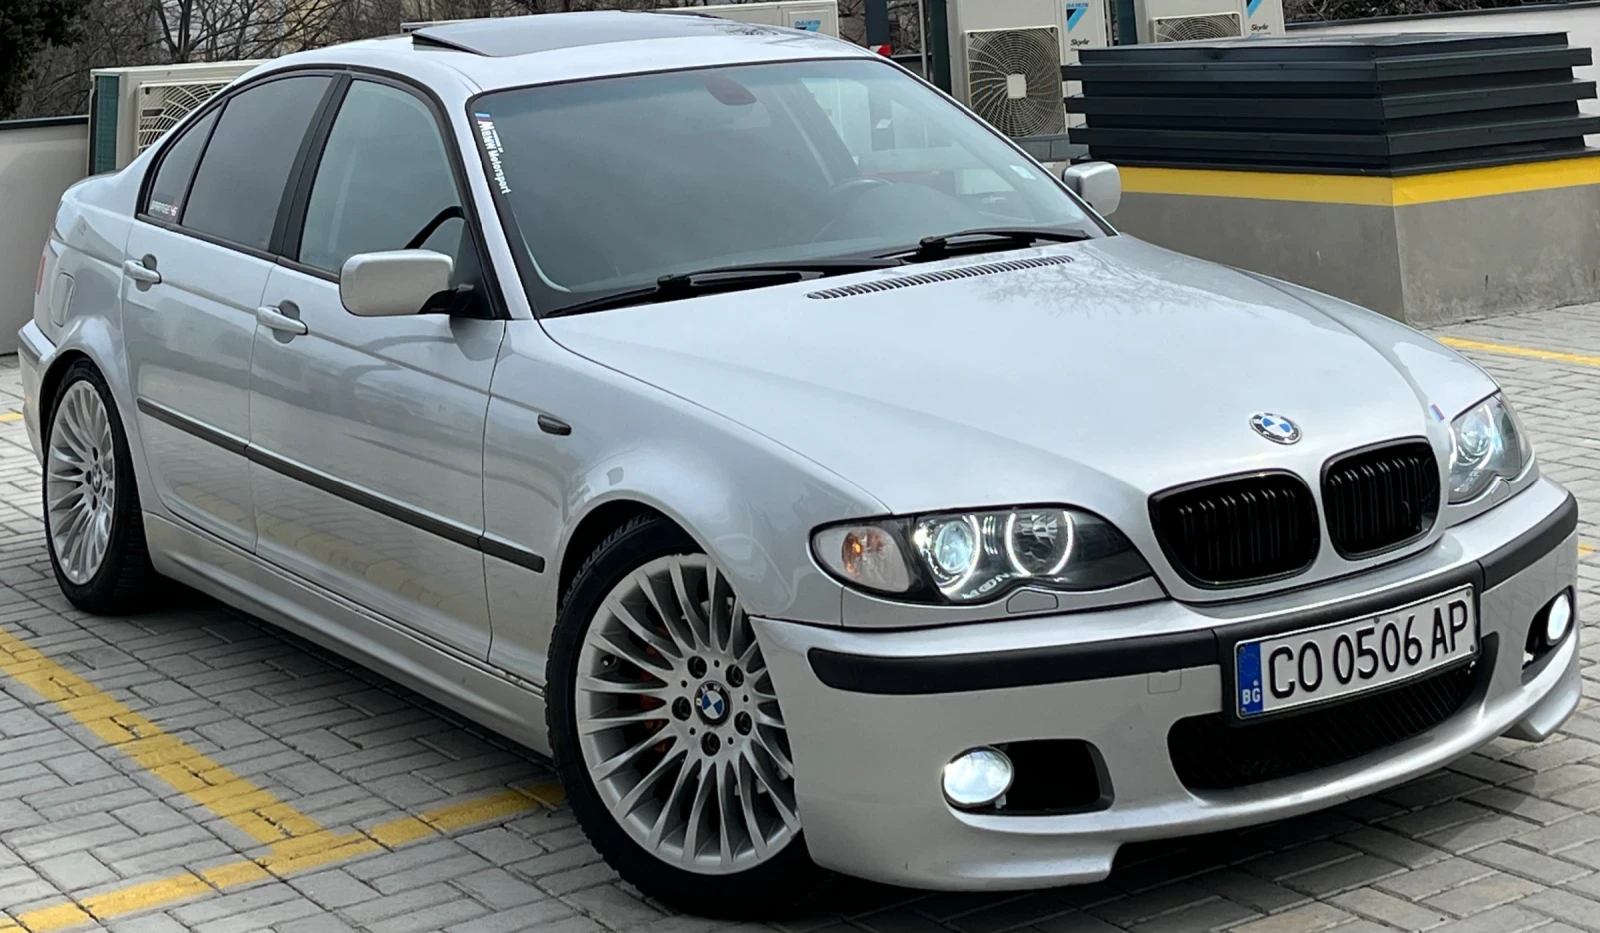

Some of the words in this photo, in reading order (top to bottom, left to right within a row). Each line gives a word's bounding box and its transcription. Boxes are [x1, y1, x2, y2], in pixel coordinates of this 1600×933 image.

[487, 149, 512, 194] Motorsport
[1268, 641, 1323, 699] CO
[1333, 614, 1423, 685] 0506
[1430, 599, 1468, 660] AP
[1241, 687, 1261, 705] BG
